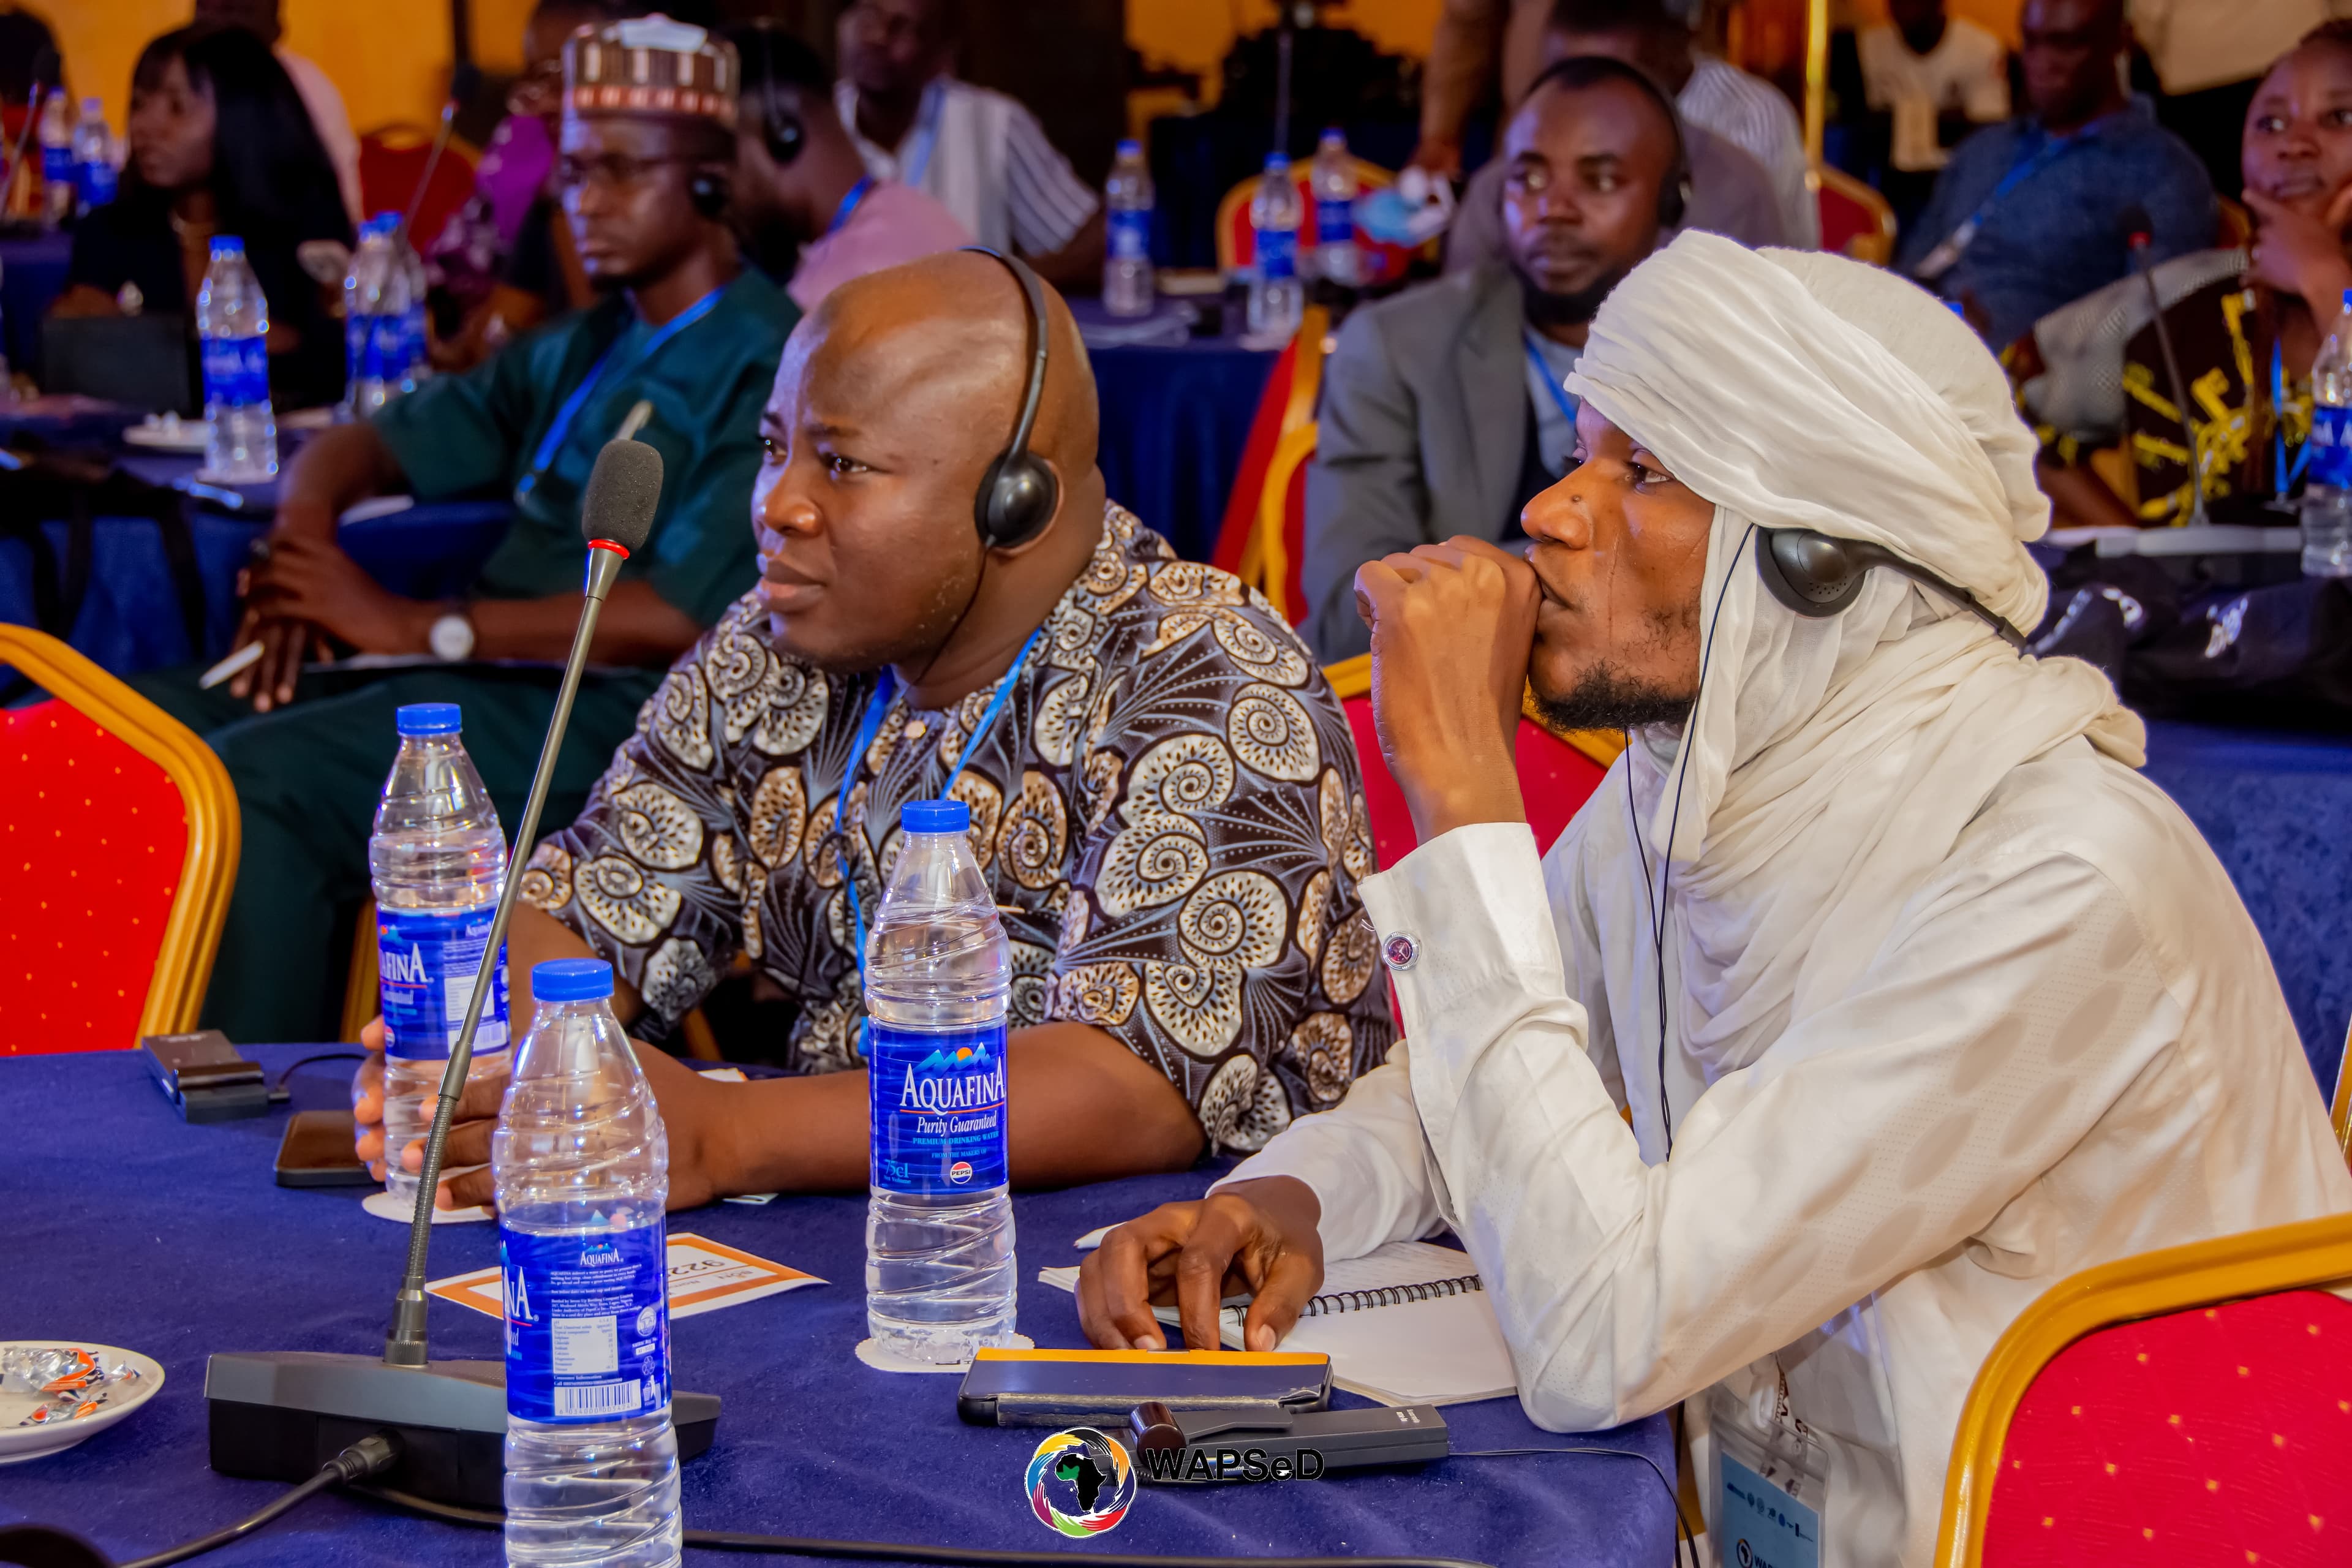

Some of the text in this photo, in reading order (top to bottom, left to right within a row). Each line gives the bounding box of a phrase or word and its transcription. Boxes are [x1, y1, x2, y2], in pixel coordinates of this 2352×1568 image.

[900, 1056, 1005, 1116] AQUAFINA
[916, 1110, 997, 1137] Purity Guaranteed
[949, 1134, 981, 1144] DRINKING
[982, 1131, 999, 1140] WATER
[580, 1248, 620, 1267] AQUAFINA
[668, 1259, 725, 1277] 922
